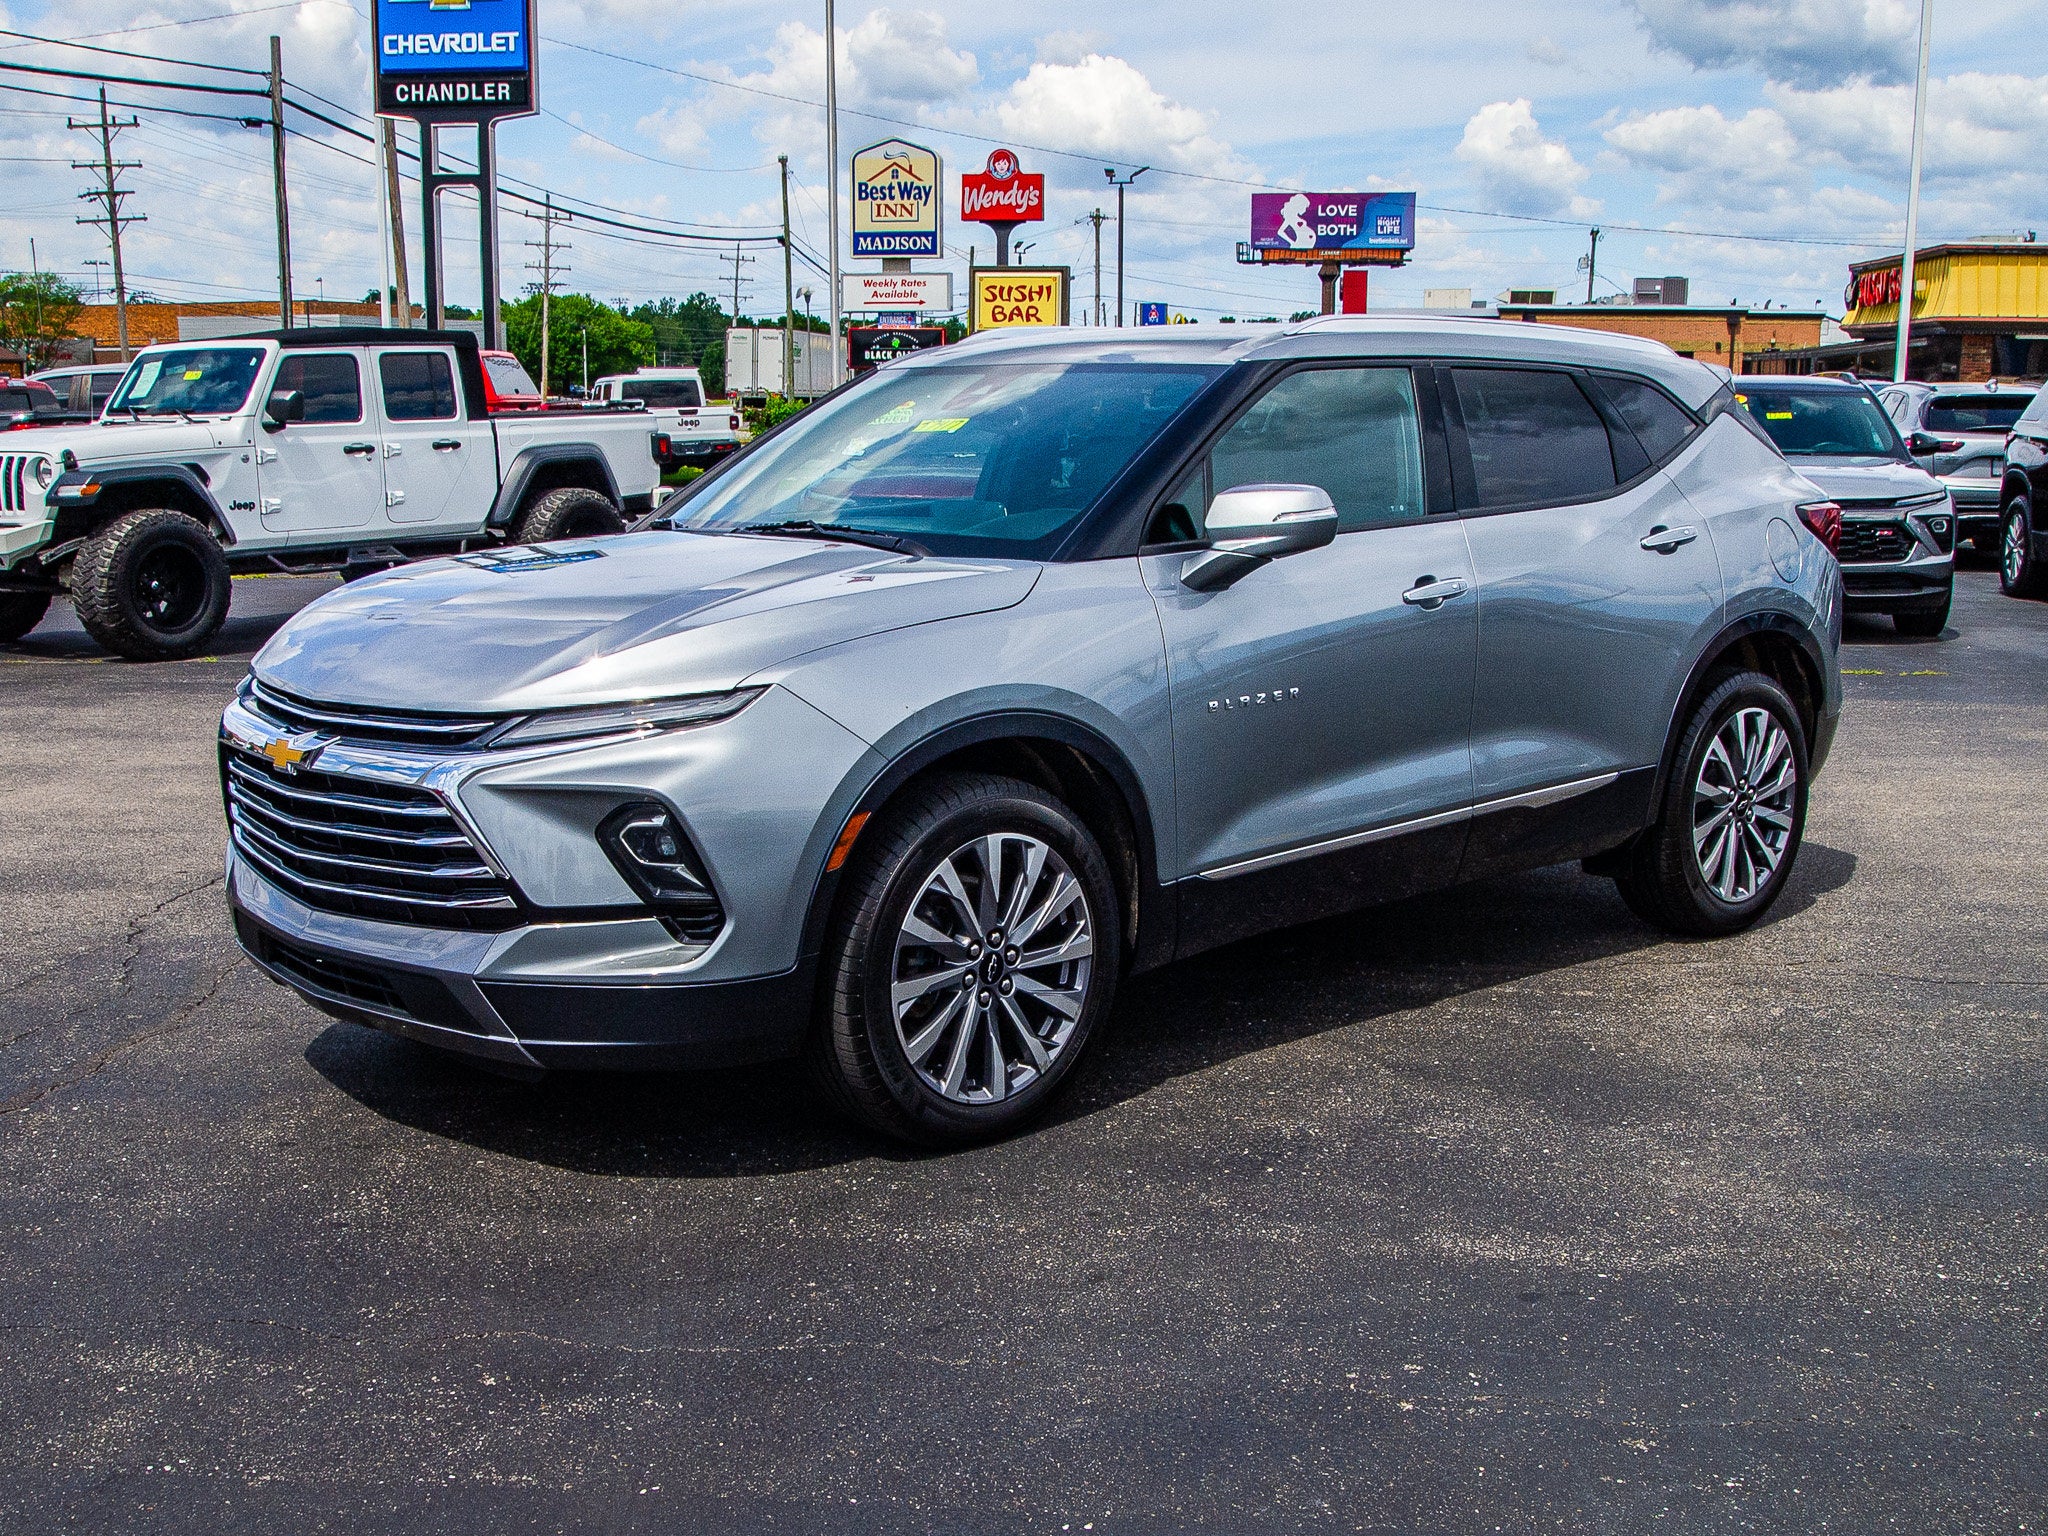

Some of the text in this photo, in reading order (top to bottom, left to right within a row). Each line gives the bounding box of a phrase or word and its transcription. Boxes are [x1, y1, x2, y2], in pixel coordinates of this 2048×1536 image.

[383, 32, 520, 55] CHEVROLET
[395, 83, 511, 102] CHANDLER
[857, 180, 933, 206] Best Way
[963, 180, 1040, 214] Wendy's
[875, 203, 914, 218] INN
[1317, 204, 1357, 217] LOVE
[1317, 224, 1357, 236] BOTH
[1377, 226, 1401, 235] LIFE
[857, 236, 933, 251] MADISON
[863, 279, 927, 289] Weekly Rates
[871, 290, 919, 299] Available
[984, 284, 1052, 303] SUSHI
[991, 305, 1043, 323] BAR
[864, 350, 893, 360] BLACK
[677, 418, 700, 428] Jeep
[228, 500, 256, 512] Jeep
[1207, 687, 1300, 712] BLAZER
